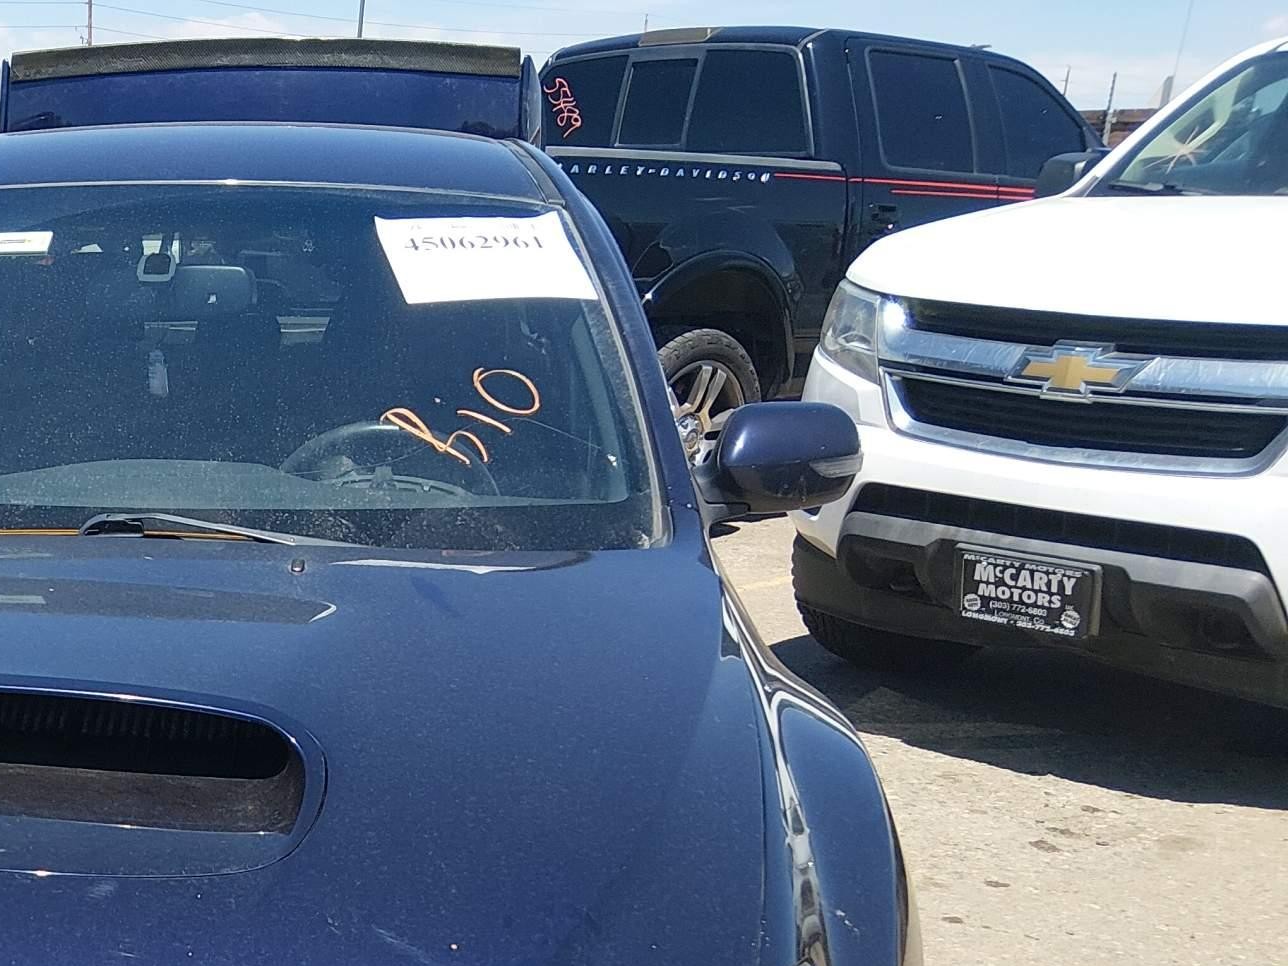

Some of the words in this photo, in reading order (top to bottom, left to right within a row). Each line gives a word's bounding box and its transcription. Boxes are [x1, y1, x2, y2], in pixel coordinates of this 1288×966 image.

[558, 163, 770, 182] ARLEY-DAVIDSON
[404, 235, 544, 251] 45062961
[977, 582, 1062, 609] MOTORS
[989, 599, 1011, 612] (303)
